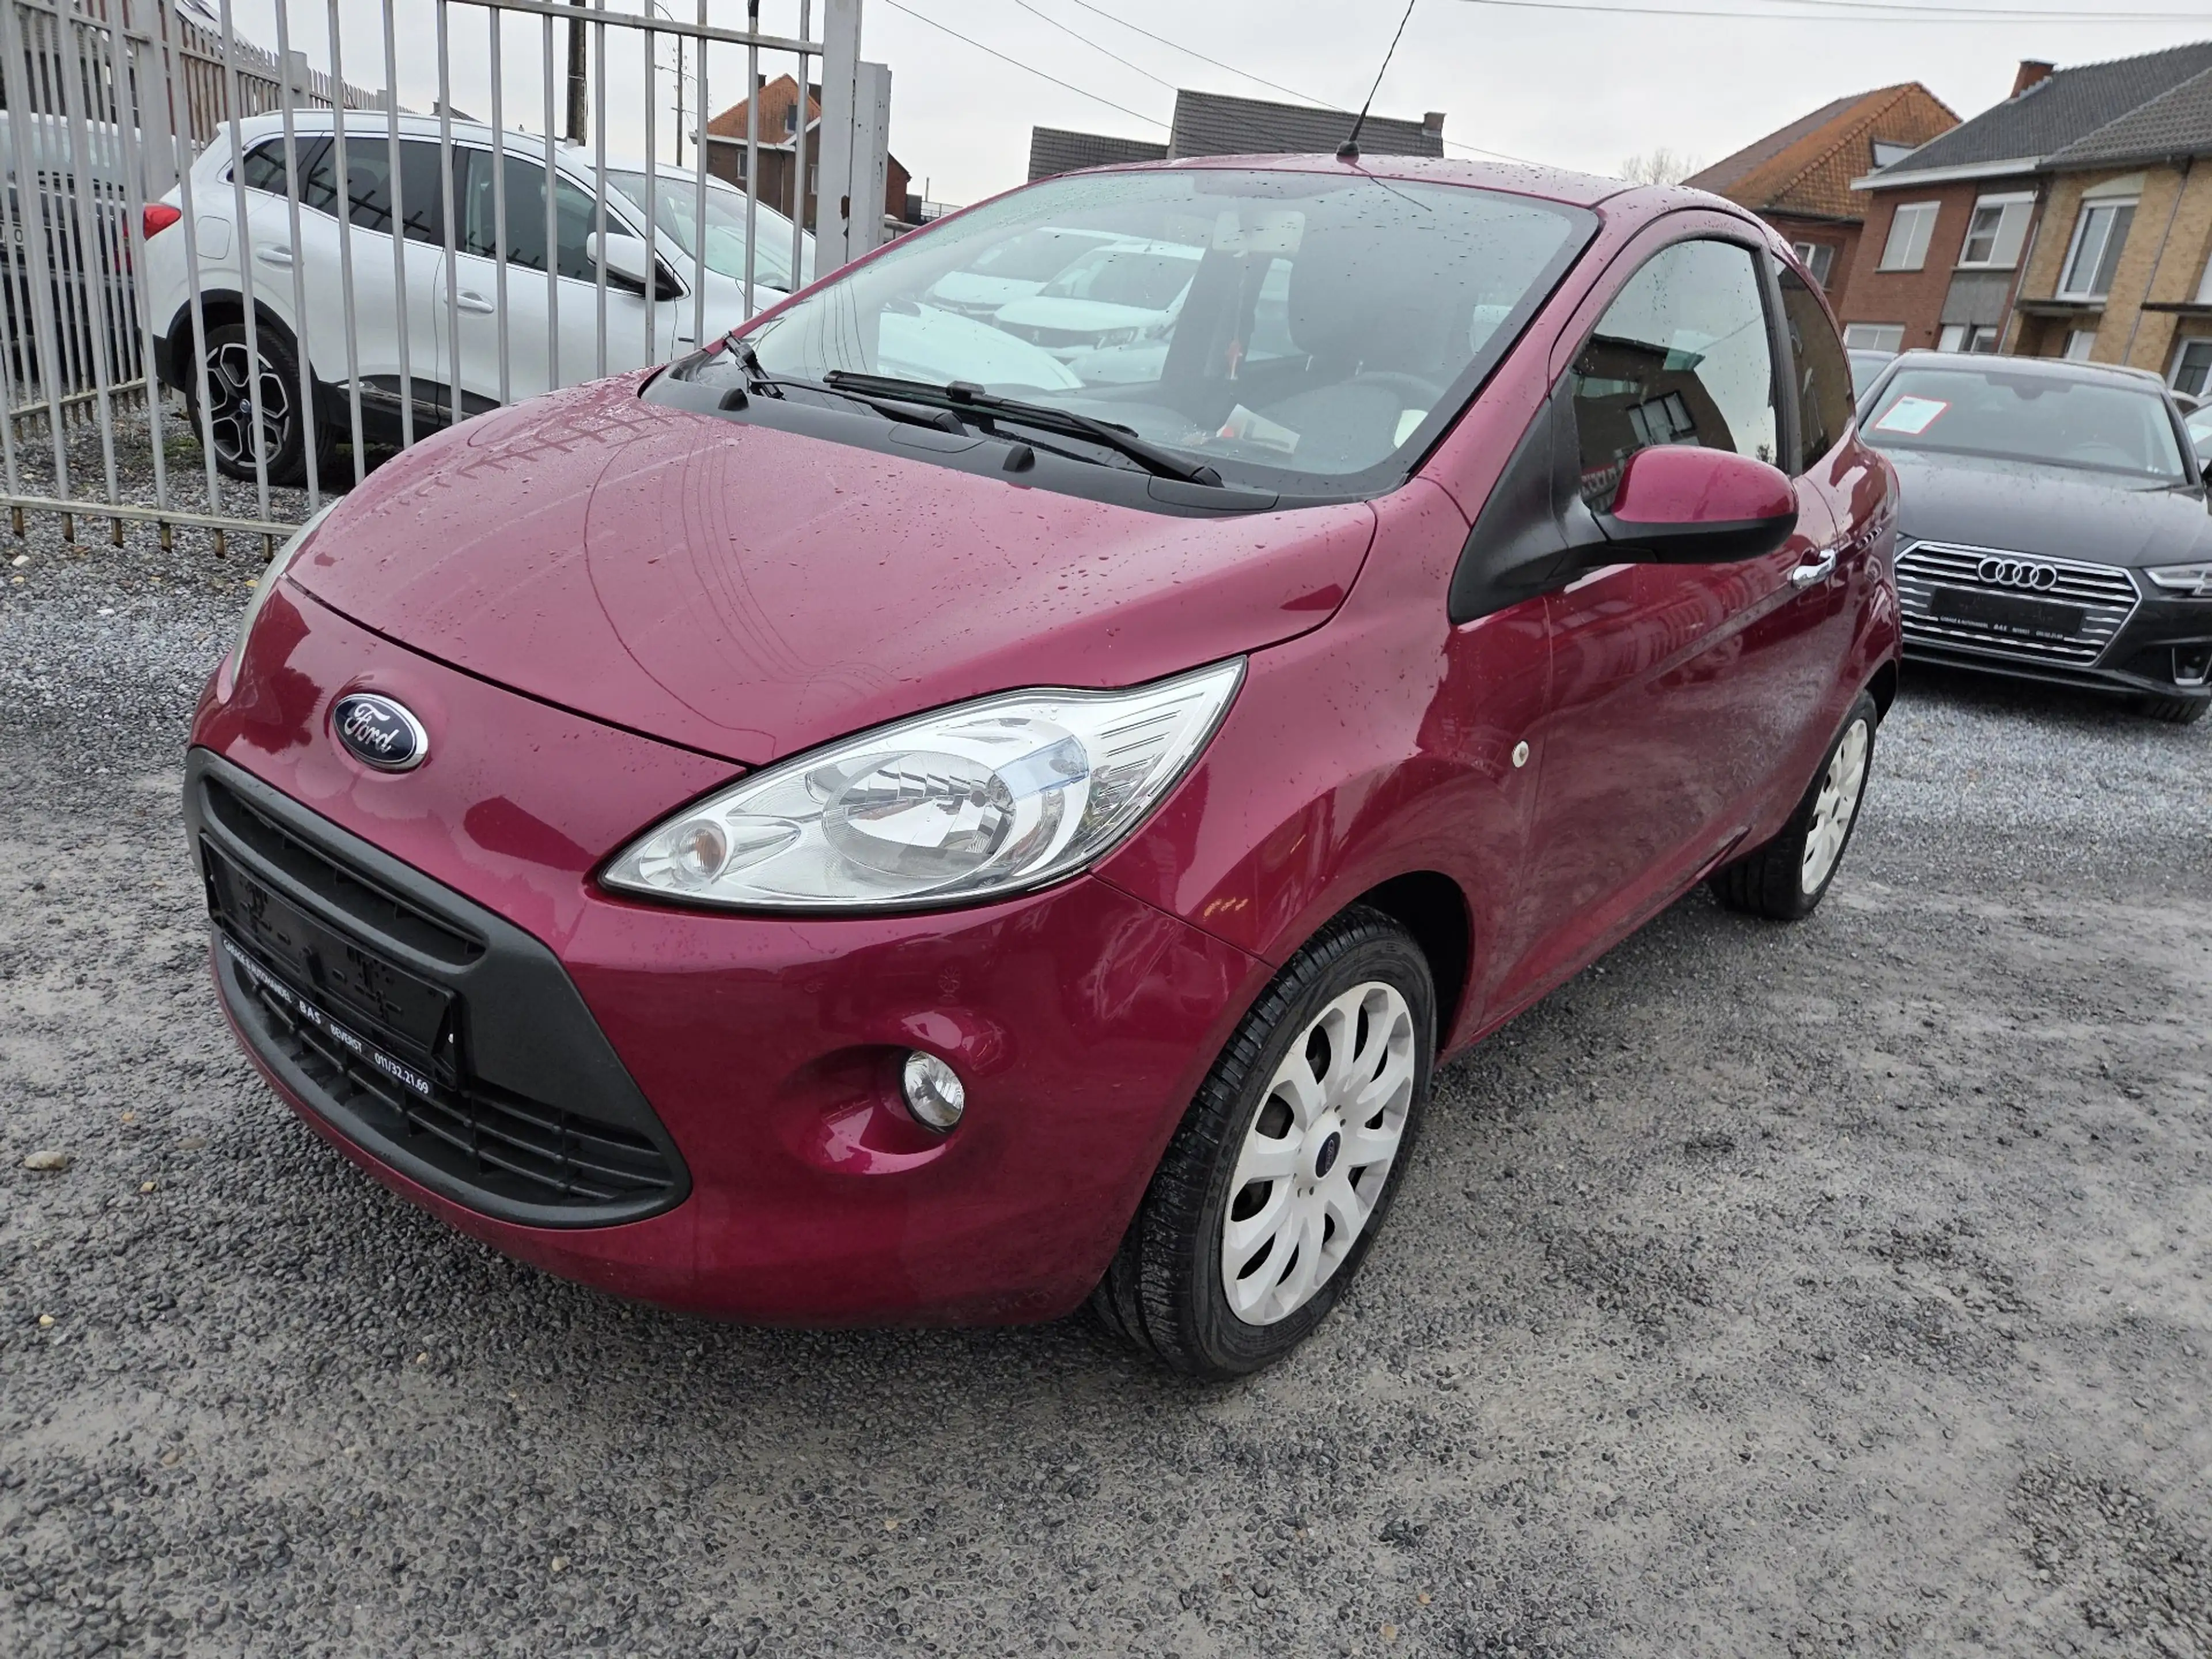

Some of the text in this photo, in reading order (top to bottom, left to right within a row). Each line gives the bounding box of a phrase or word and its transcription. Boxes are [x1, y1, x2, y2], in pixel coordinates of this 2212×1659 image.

[344, 702, 400, 753] Ford
[299, 999, 321, 1024] BAS
[374, 1052, 429, 1094] 011/32.21.69
